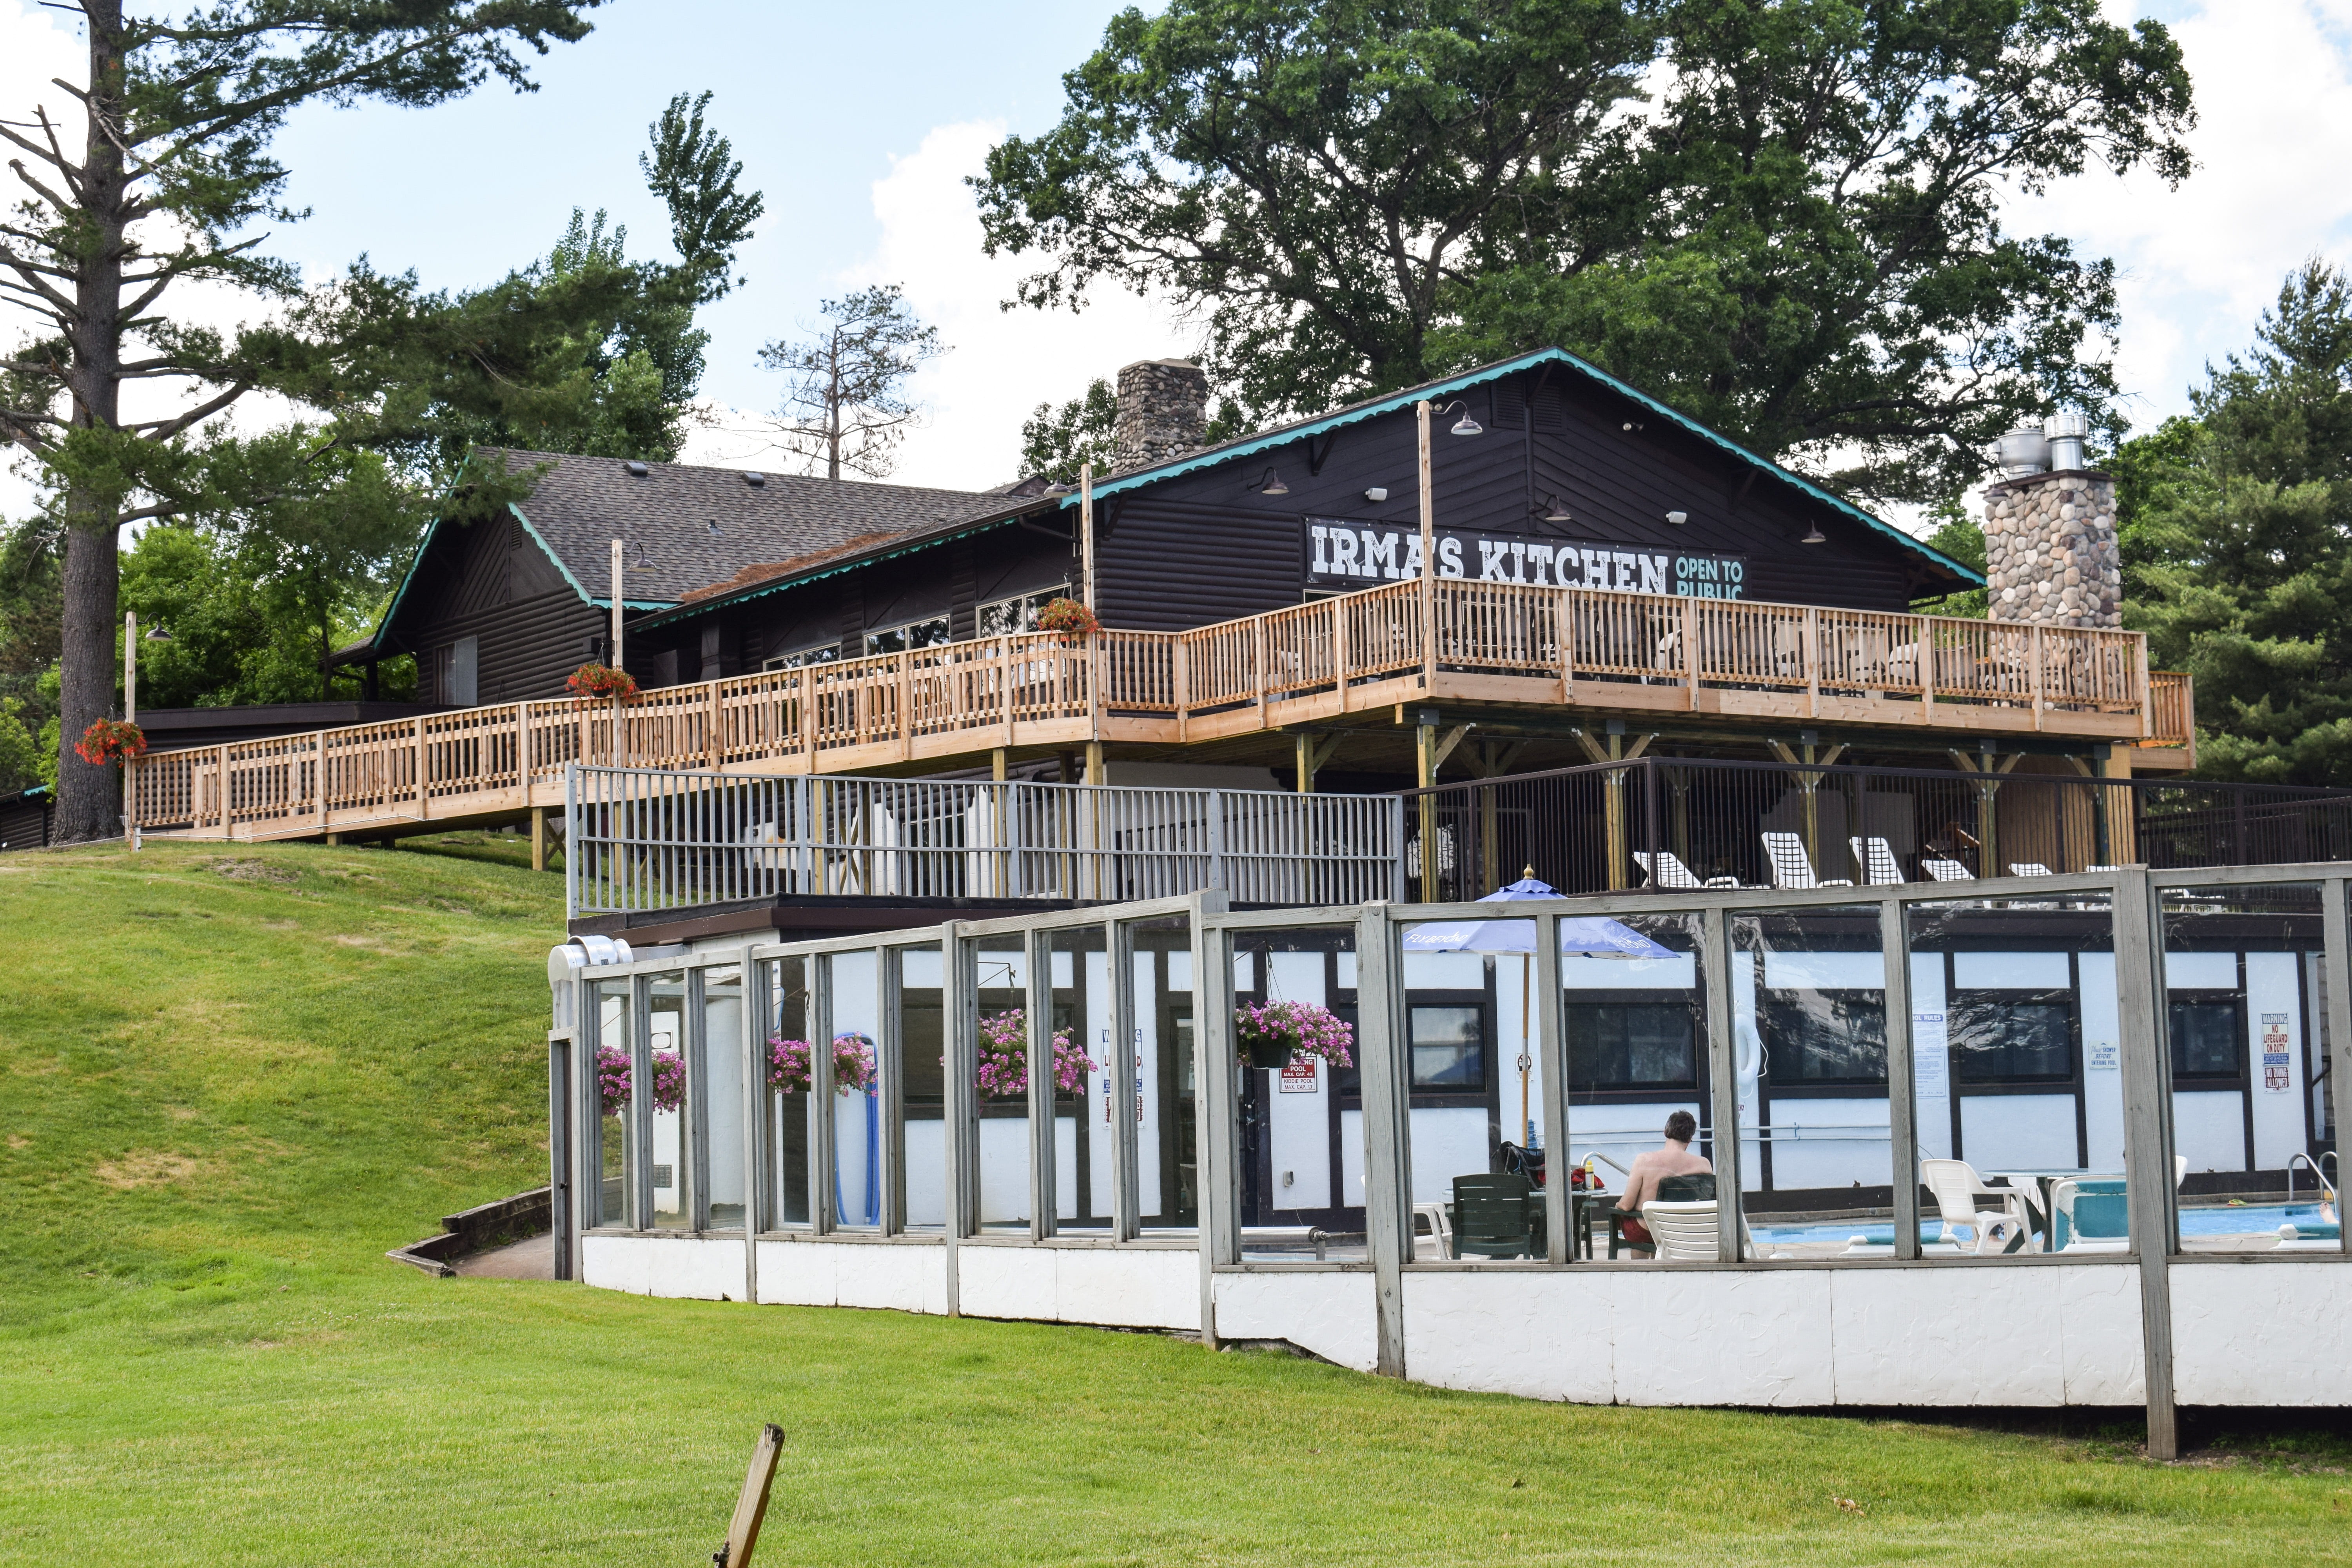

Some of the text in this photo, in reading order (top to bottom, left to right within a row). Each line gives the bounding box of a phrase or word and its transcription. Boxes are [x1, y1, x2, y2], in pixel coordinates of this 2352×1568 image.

[1312, 526, 1668, 594] IRMA'S KITCHEN
[1676, 557, 1742, 583] OPEN TO
[1677, 581, 1742, 600] PUBLIC
[1405, 932, 1468, 943] FLY BEYOND
[2262, 1014, 2287, 1024] WARNING
[2272, 1024, 2278, 1033] NO
[2264, 1034, 2287, 1043] LIFEGUARD
[2267, 1044, 2285, 1053] ON DUTY
[2266, 1068, 2287, 1078] NO DIVING
[2267, 1078, 2288, 1088] ALLOWED
